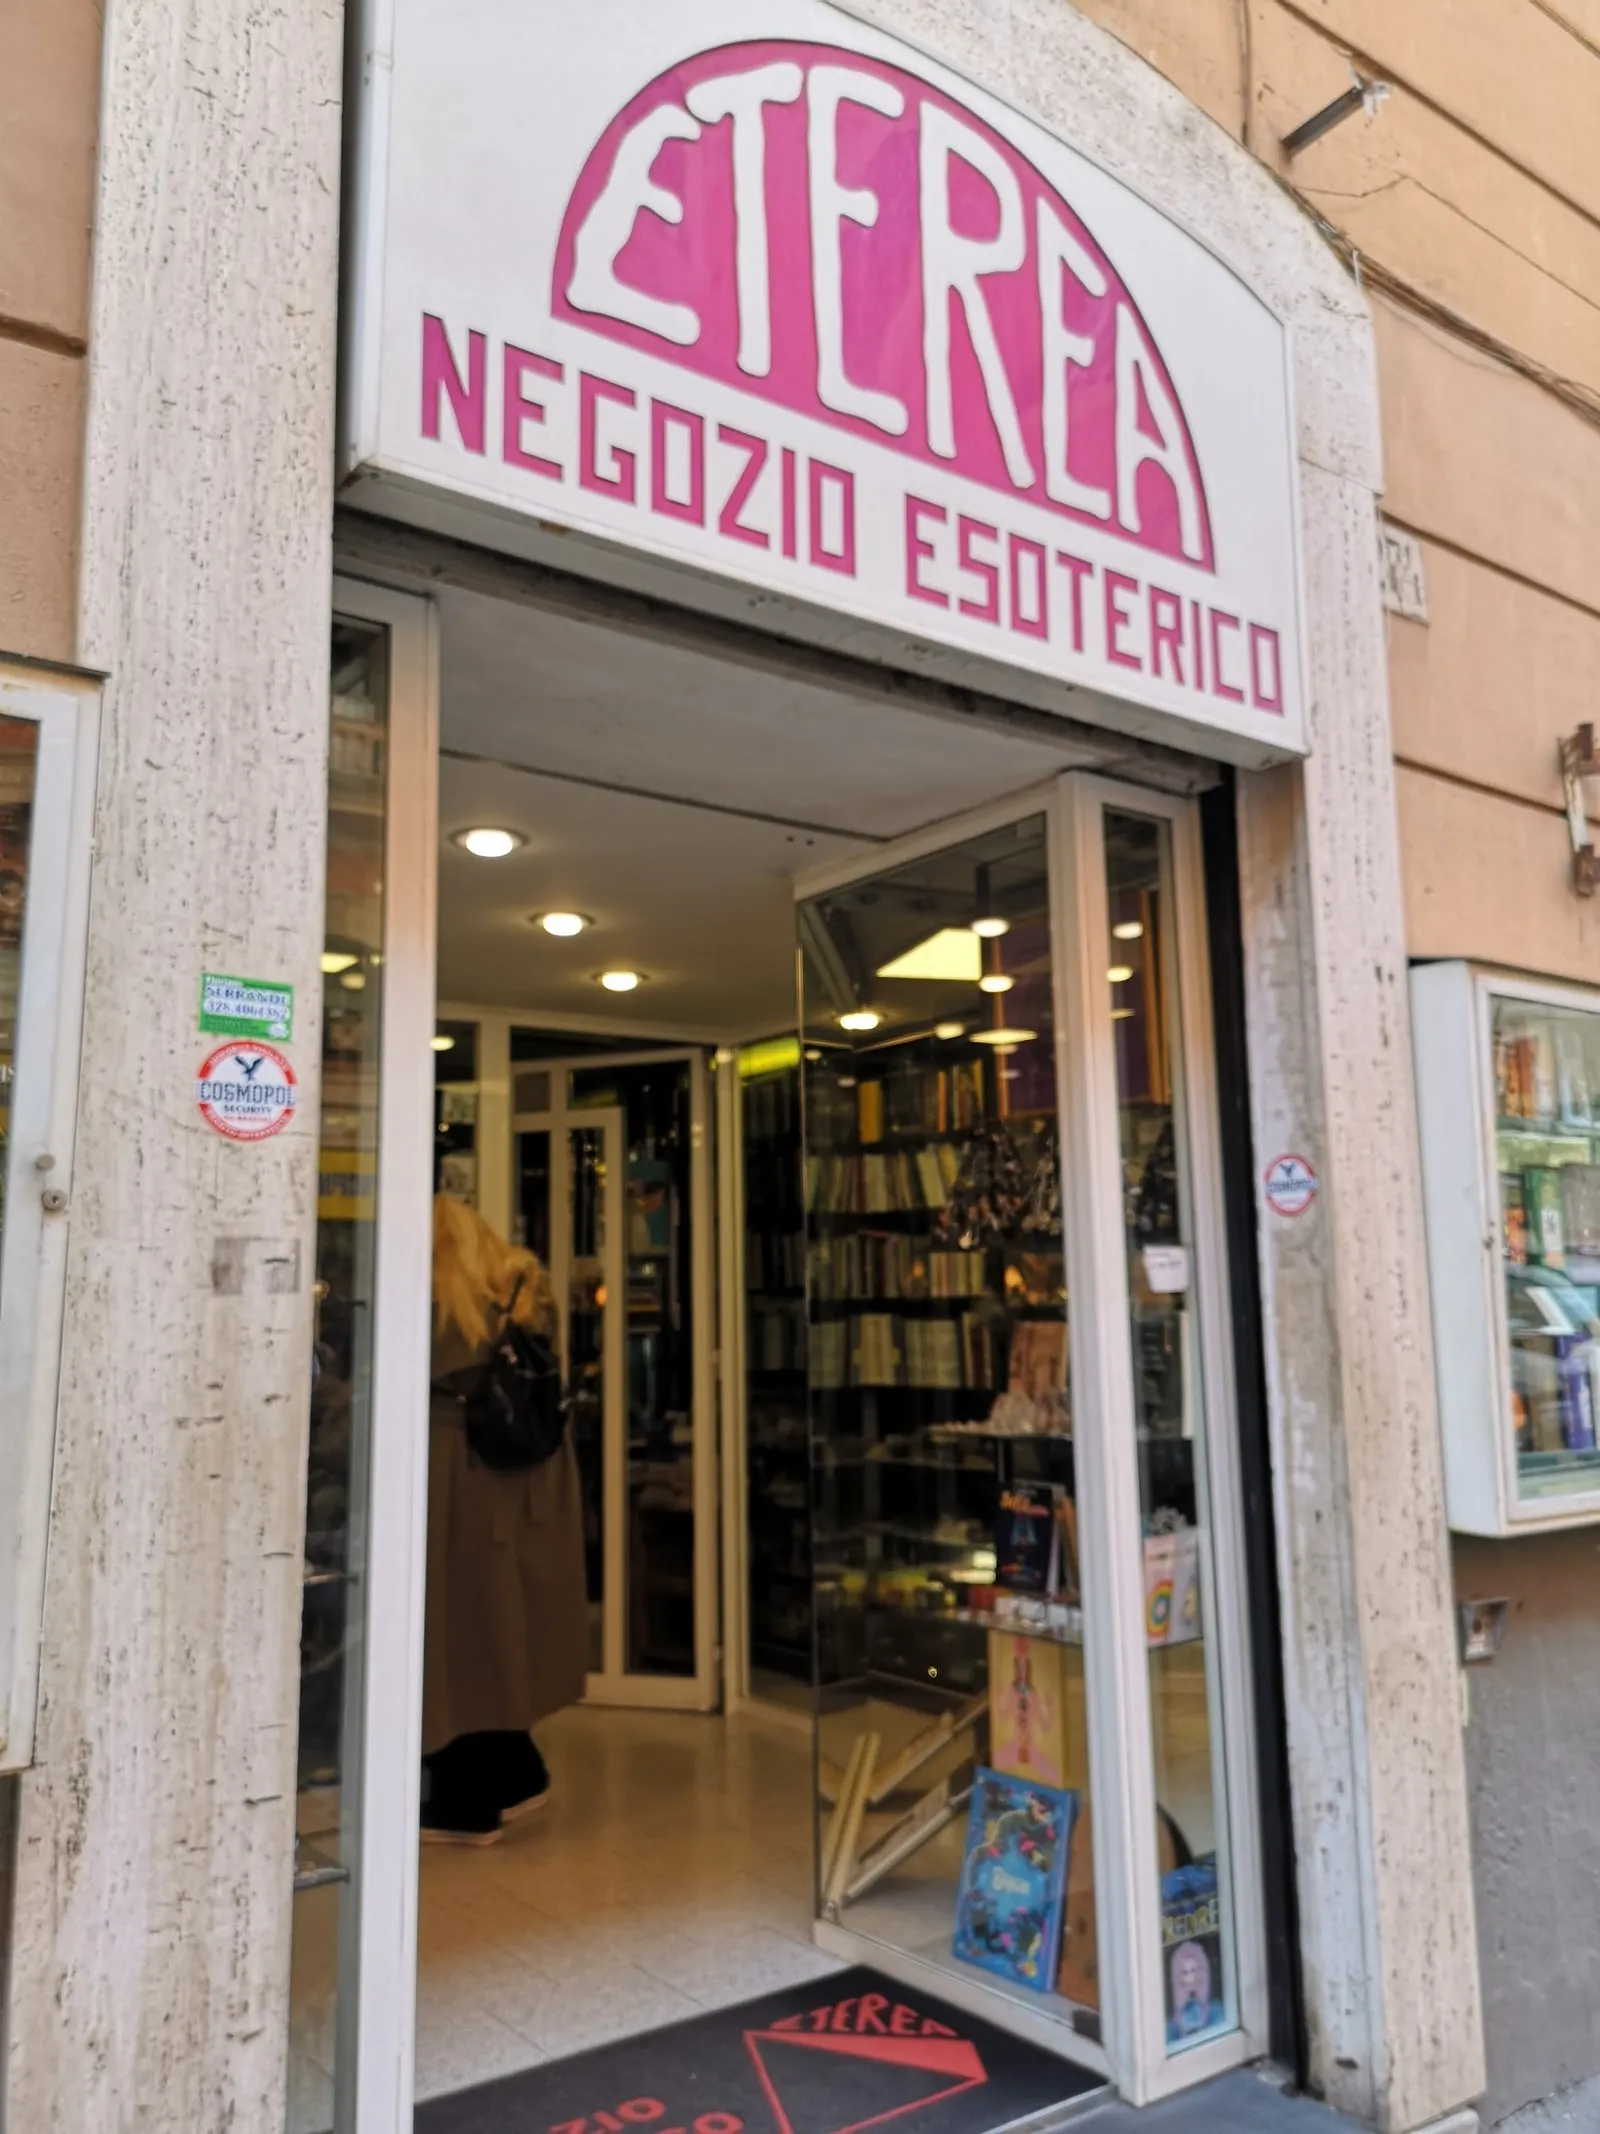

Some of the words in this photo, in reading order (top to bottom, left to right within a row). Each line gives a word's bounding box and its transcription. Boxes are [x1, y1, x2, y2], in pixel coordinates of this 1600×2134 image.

[565, 62, 1205, 562] ETEREA
[420, 311, 857, 579] NEGOZIO
[904, 493, 1284, 718] ESOTERICO
[200, 1081, 295, 1107] COSMOPOL
[223, 1105, 273, 1114] SECURITY
